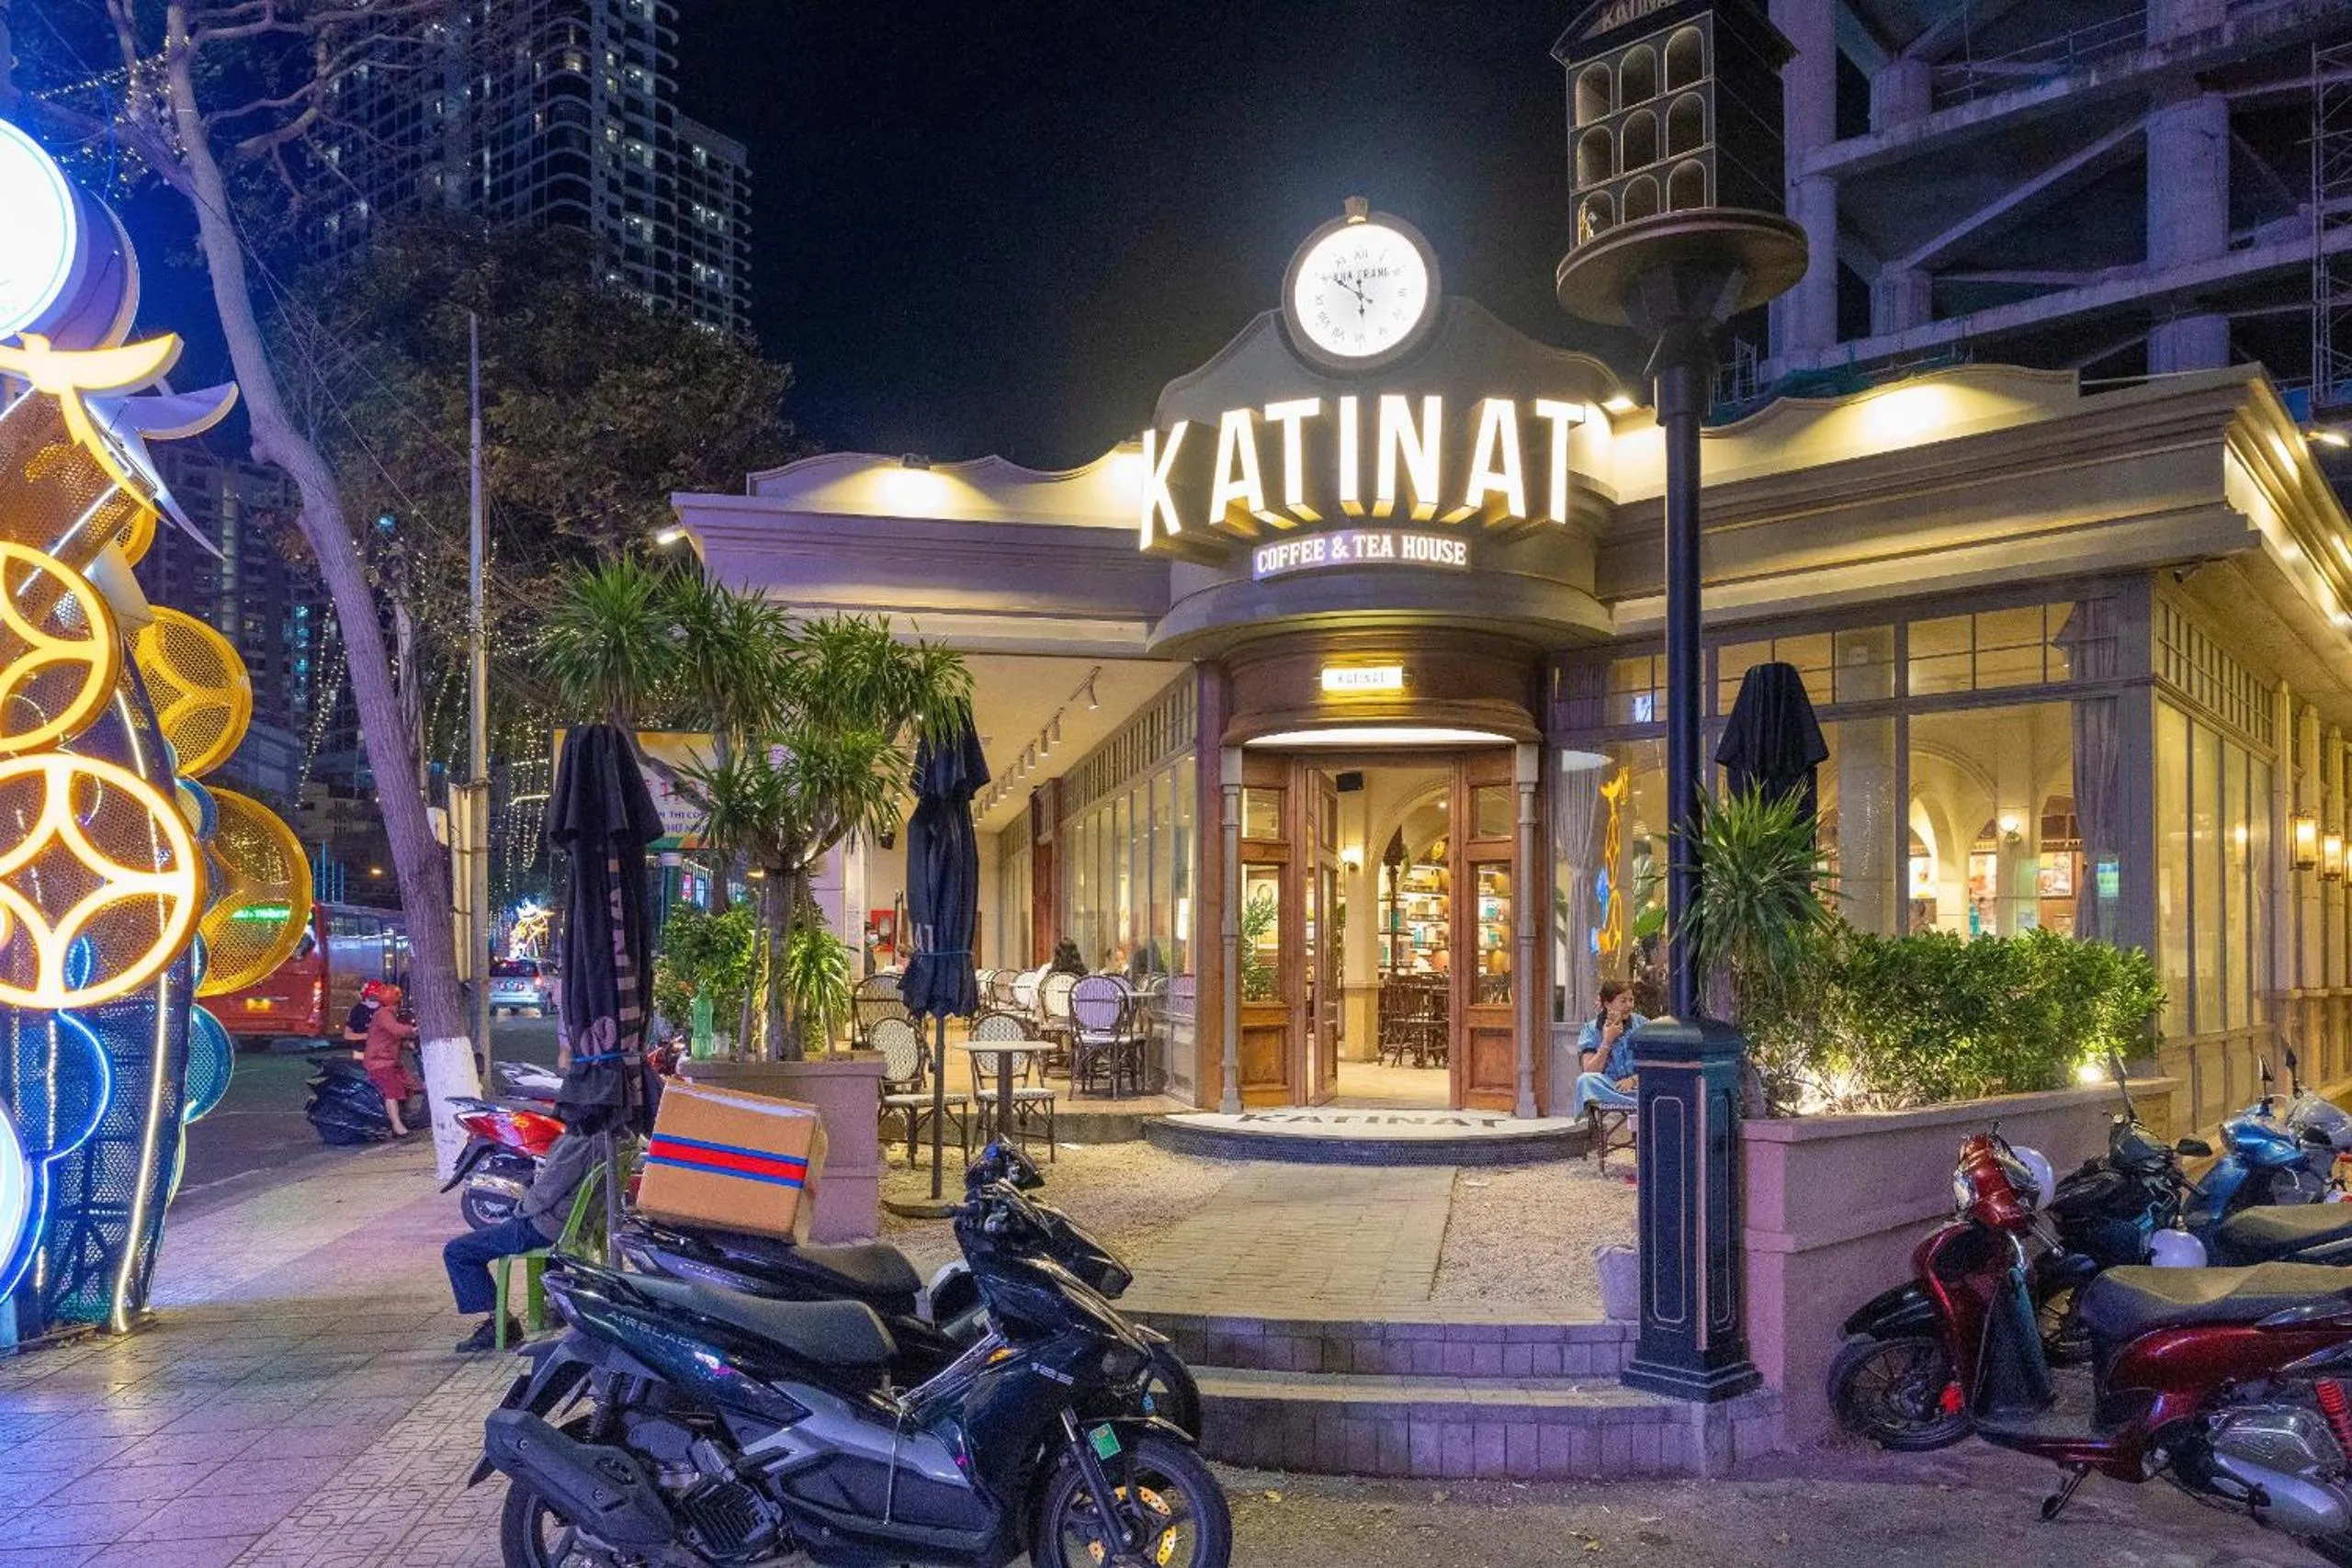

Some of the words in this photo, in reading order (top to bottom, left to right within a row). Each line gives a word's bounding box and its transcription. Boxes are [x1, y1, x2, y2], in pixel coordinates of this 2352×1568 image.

[1139, 395, 1585, 552] KATINAT
[1257, 538, 1326, 573] COFFEE
[1331, 536, 1350, 559] &
[1353, 535, 1395, 558] TEA
[1402, 535, 1467, 566] HOUSE
[1238, 1113, 1506, 1128] KATINAT
